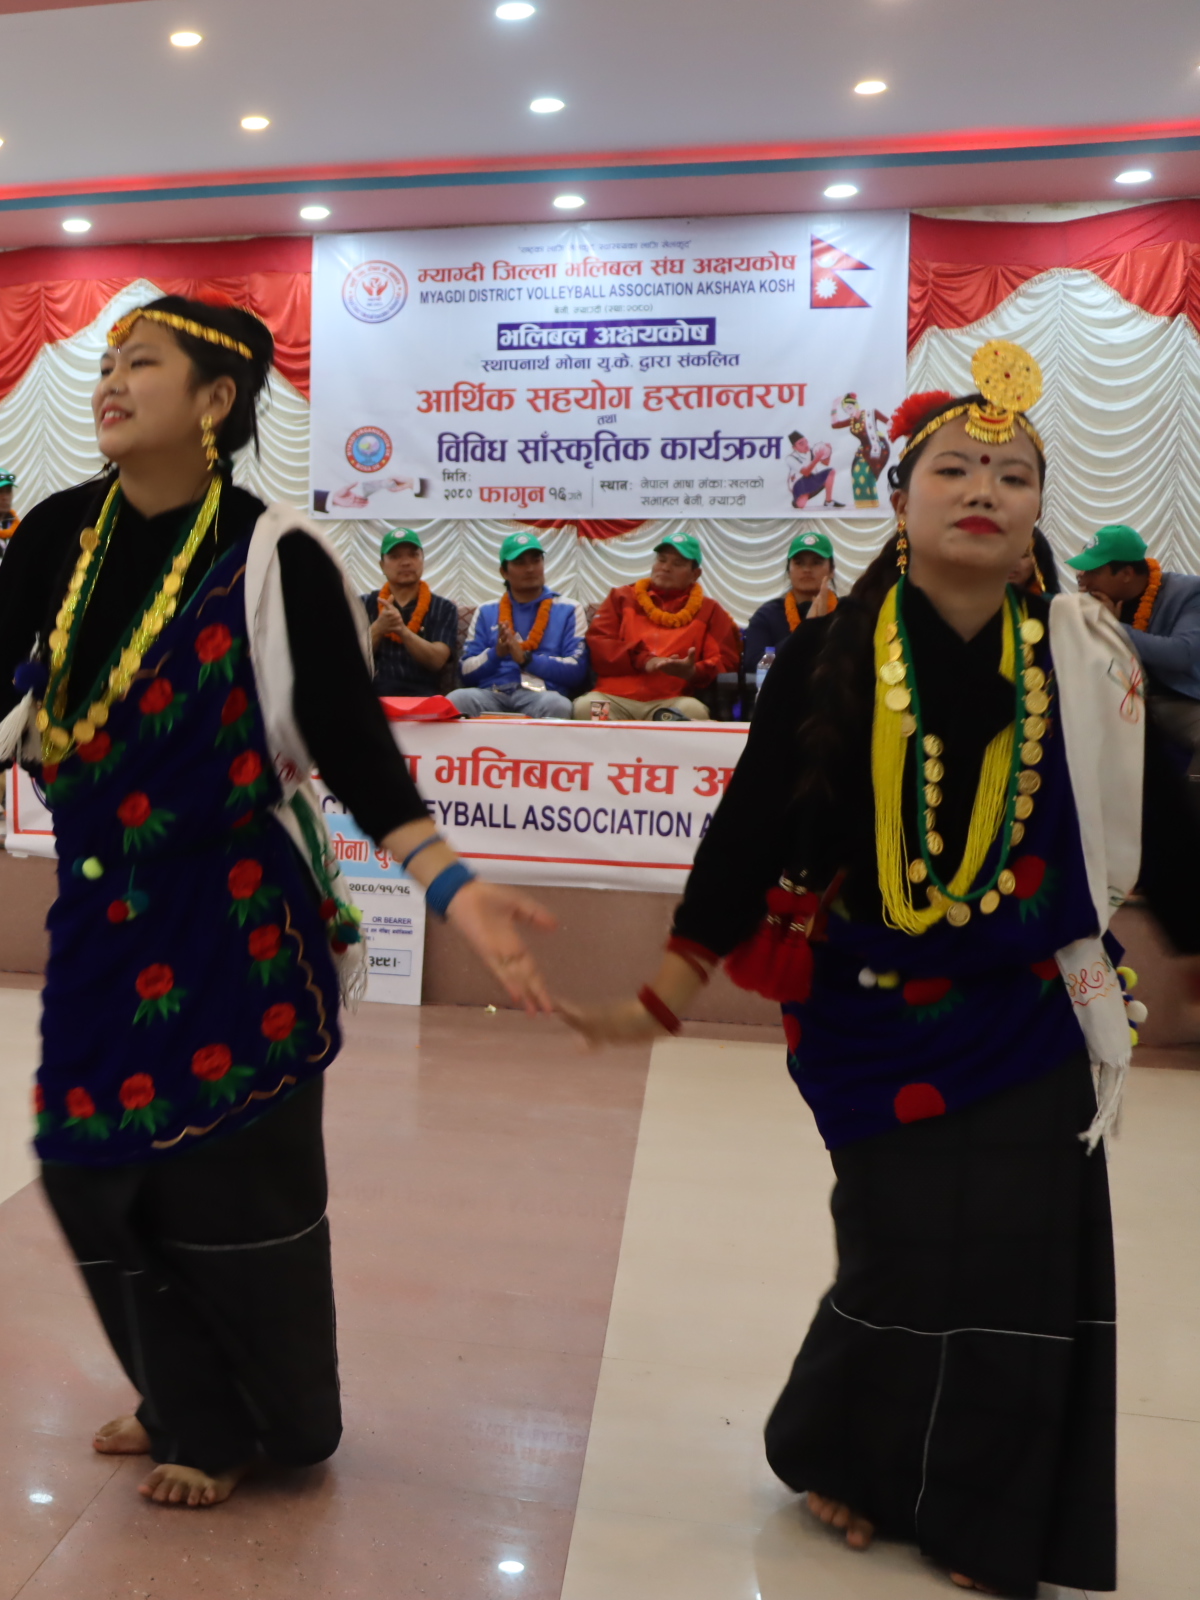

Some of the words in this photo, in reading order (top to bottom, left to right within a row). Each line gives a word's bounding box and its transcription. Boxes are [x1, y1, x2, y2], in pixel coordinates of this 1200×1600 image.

[418, 262, 485, 283] म्याग्दी
[493, 260, 557, 281] जिल्ला
[565, 256, 643, 278] भलिबल
[651, 256, 685, 276] संघ
[693, 251, 797, 275] अक्षयकोष
[420, 290, 465, 304] MYAGDI
[469, 287, 523, 303] DISTRICT
[526, 284, 605, 300] VOLLEYBALL
[609, 282, 693, 298] ASSOCIATION
[697, 279, 756, 296] AKSHAYA
[760, 278, 795, 293] KOSH
[499, 323, 588, 347] भलिबल
[594, 320, 709, 346] अक्षयकोष
[481, 355, 550, 373] स्थापनार्थ
[555, 354, 591, 370] मोना
[639, 354, 672, 373] द्वारा
[677, 350, 741, 368] संकलित
[416, 381, 517, 413] आर्थिक
[526, 379, 633, 413] सहयोग
[643, 383, 807, 412] हस्तान्तरण
[597, 414, 617, 425] तथा
[437, 431, 509, 463] विविध
[517, 430, 652, 469] साँस्कृतिक
[660, 430, 784, 462] कार्यक्रम
[640, 477, 669, 489] नेपाल
[673, 478, 694, 489] भाषा
[444, 488, 473, 501] २०८०
[479, 486, 546, 509] फागुन
[549, 487, 566, 501] १६
[434, 746, 594, 792] भलिबल
[607, 756, 679, 796] संघ
[423, 798, 516, 829] EYBALL
[522, 804, 692, 838] ASSOCIATION
[349, 883, 410, 895] २०८०/११/१६
[384, 917, 412, 925] BEARER
